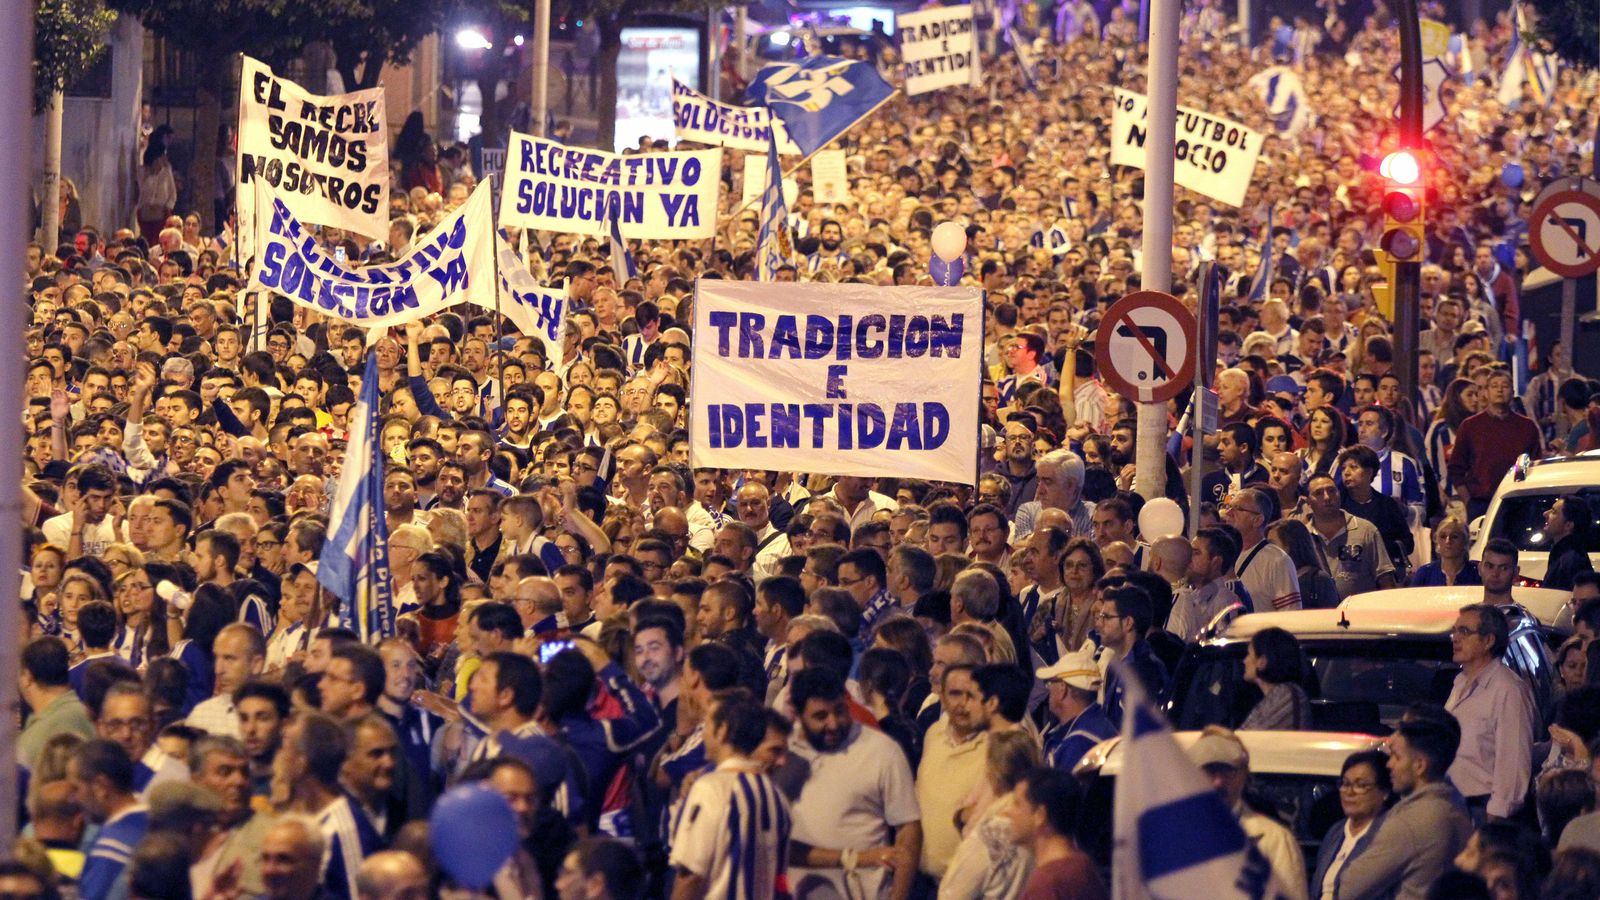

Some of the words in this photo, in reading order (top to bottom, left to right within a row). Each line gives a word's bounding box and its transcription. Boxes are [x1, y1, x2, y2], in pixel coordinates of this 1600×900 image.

[254, 71, 286, 112] EL
[269, 115, 366, 173] SOMOS
[520, 139, 701, 187] RECREATIVO
[1127, 124, 1227, 173] NOCIO
[241, 153, 380, 214] NOSOTROS
[516, 178, 644, 225] SOLUCION
[659, 193, 700, 228] YA
[428, 250, 469, 300] YA
[709, 311, 964, 360] TRADICION
[826, 365, 848, 399] E
[707, 402, 950, 450] IDENTIDAD
